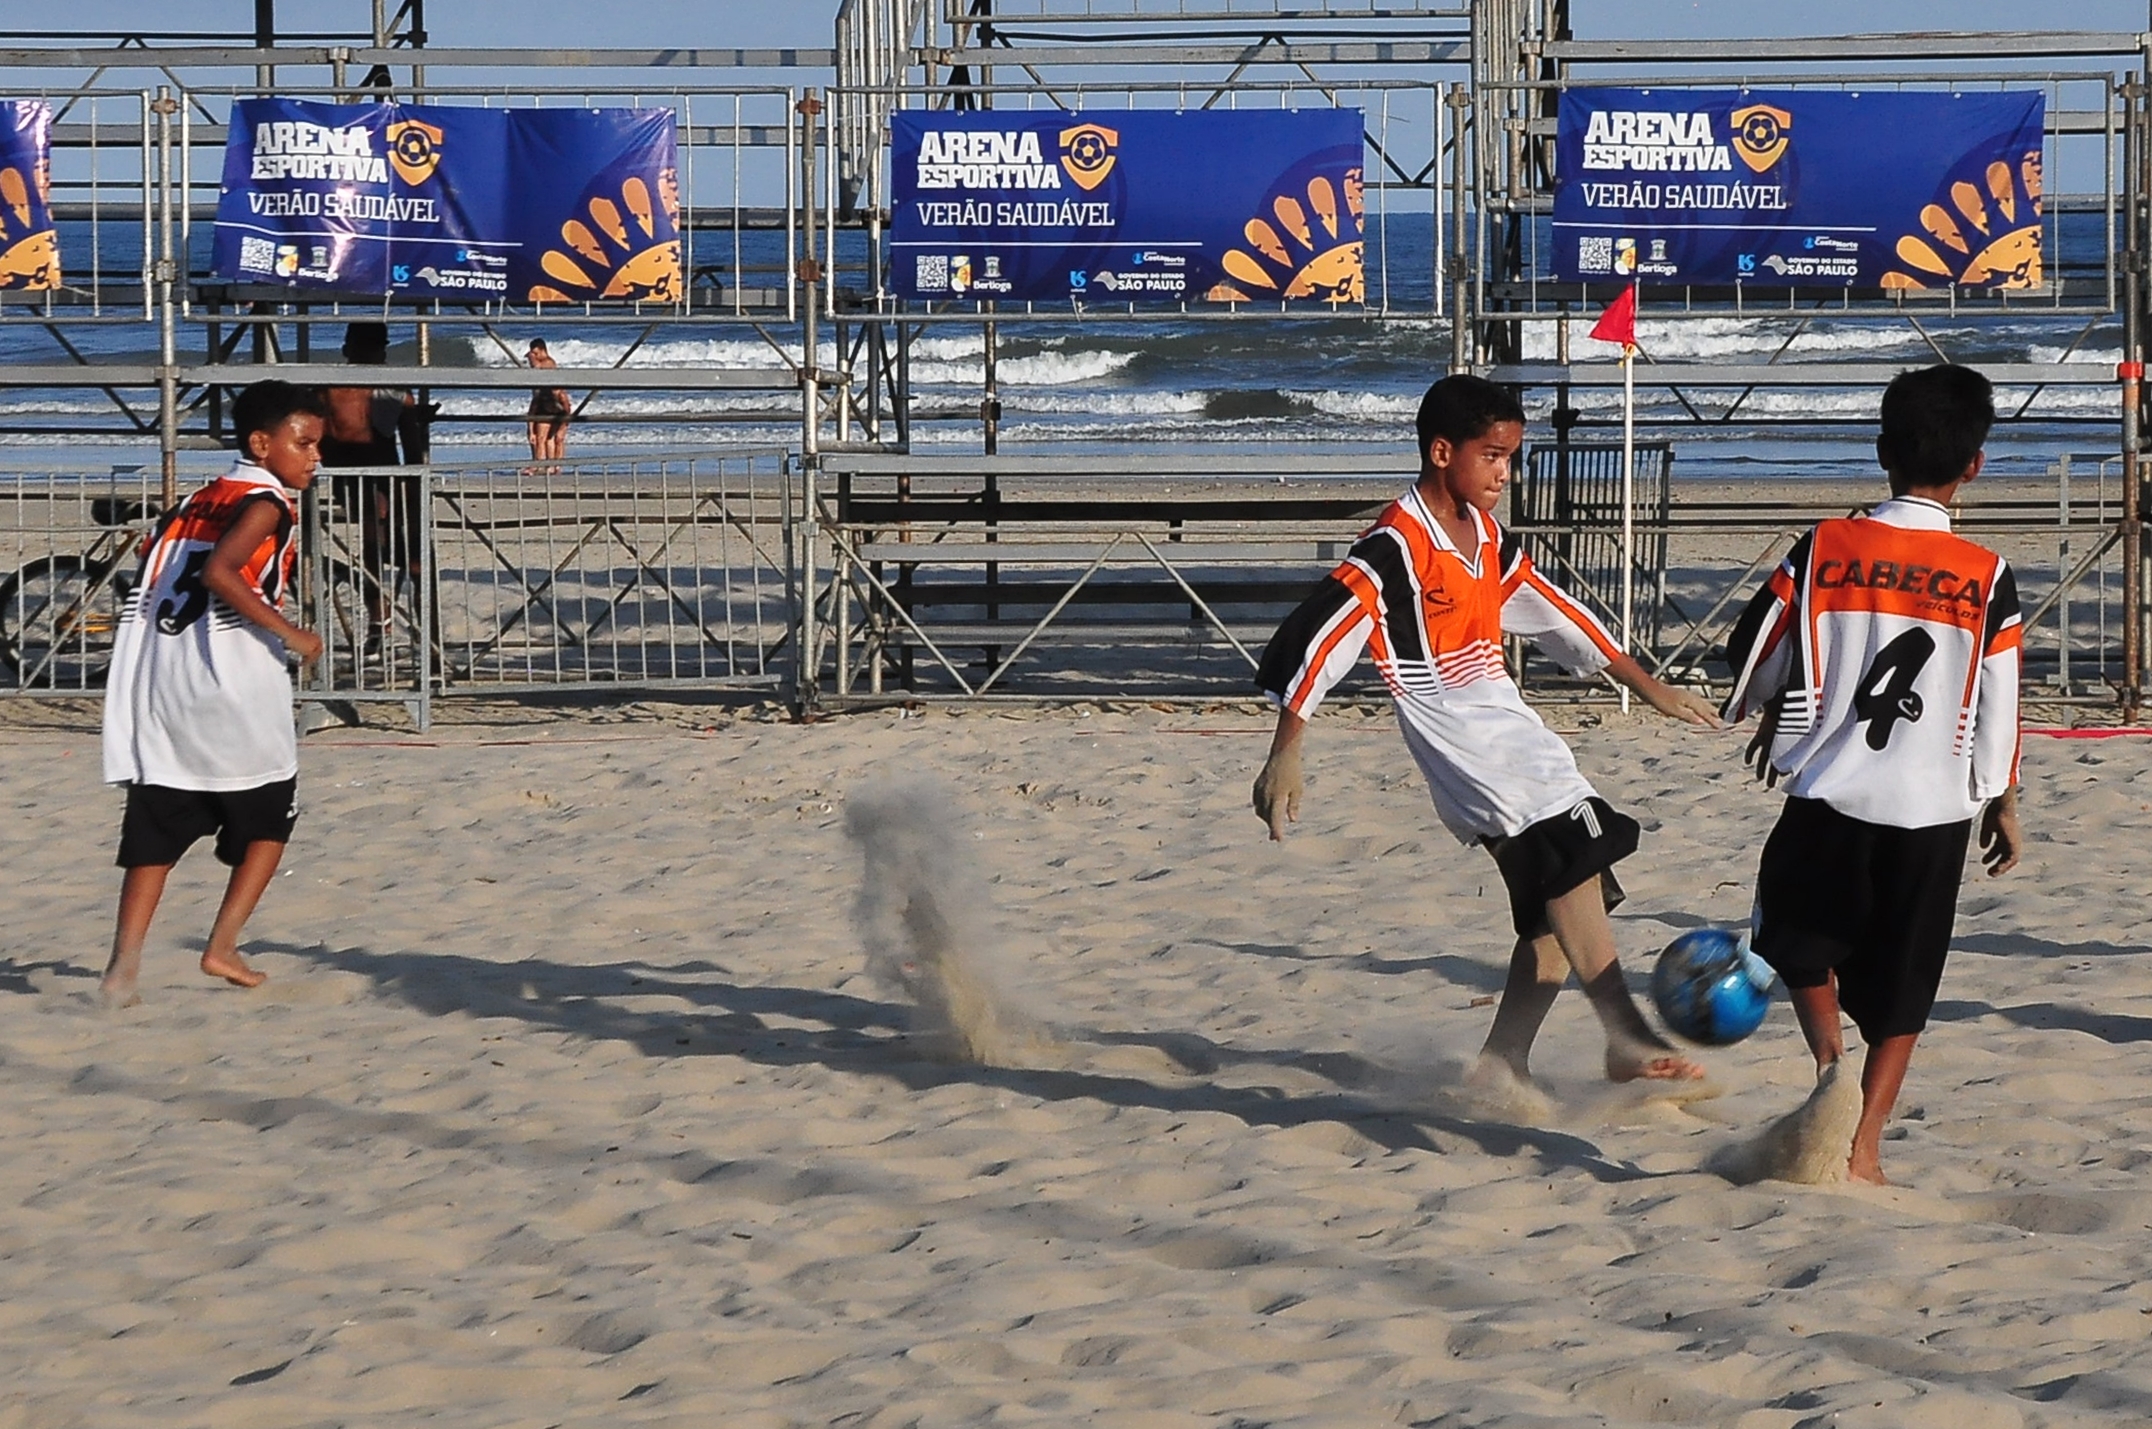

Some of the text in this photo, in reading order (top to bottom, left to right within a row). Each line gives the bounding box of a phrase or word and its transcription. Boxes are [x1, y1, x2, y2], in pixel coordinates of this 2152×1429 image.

[252, 121, 372, 156] ARENA
[1584, 111, 1714, 146] ARENA
[917, 131, 1043, 164] ARENA
[1582, 144, 1733, 171] ESPORTIVA
[251, 155, 389, 183] ESPORTIVA
[917, 164, 1061, 189] ESPORTIVA
[247, 188, 440, 223] VERÃO SAUDÁVEL
[1581, 180, 1787, 209] VERÃO SAUDÁVEL
[916, 197, 1115, 226] VERÃO SAUDÁVEL
[440, 275, 507, 290] SÃO PAULO
[1637, 263, 1678, 277] Bertioga
[1787, 262, 1858, 276] SÃO PAULO
[1117, 278, 1186, 291] SÃO PAULO
[156, 550, 212, 636] 5
[1854, 626, 1936, 751] 4
